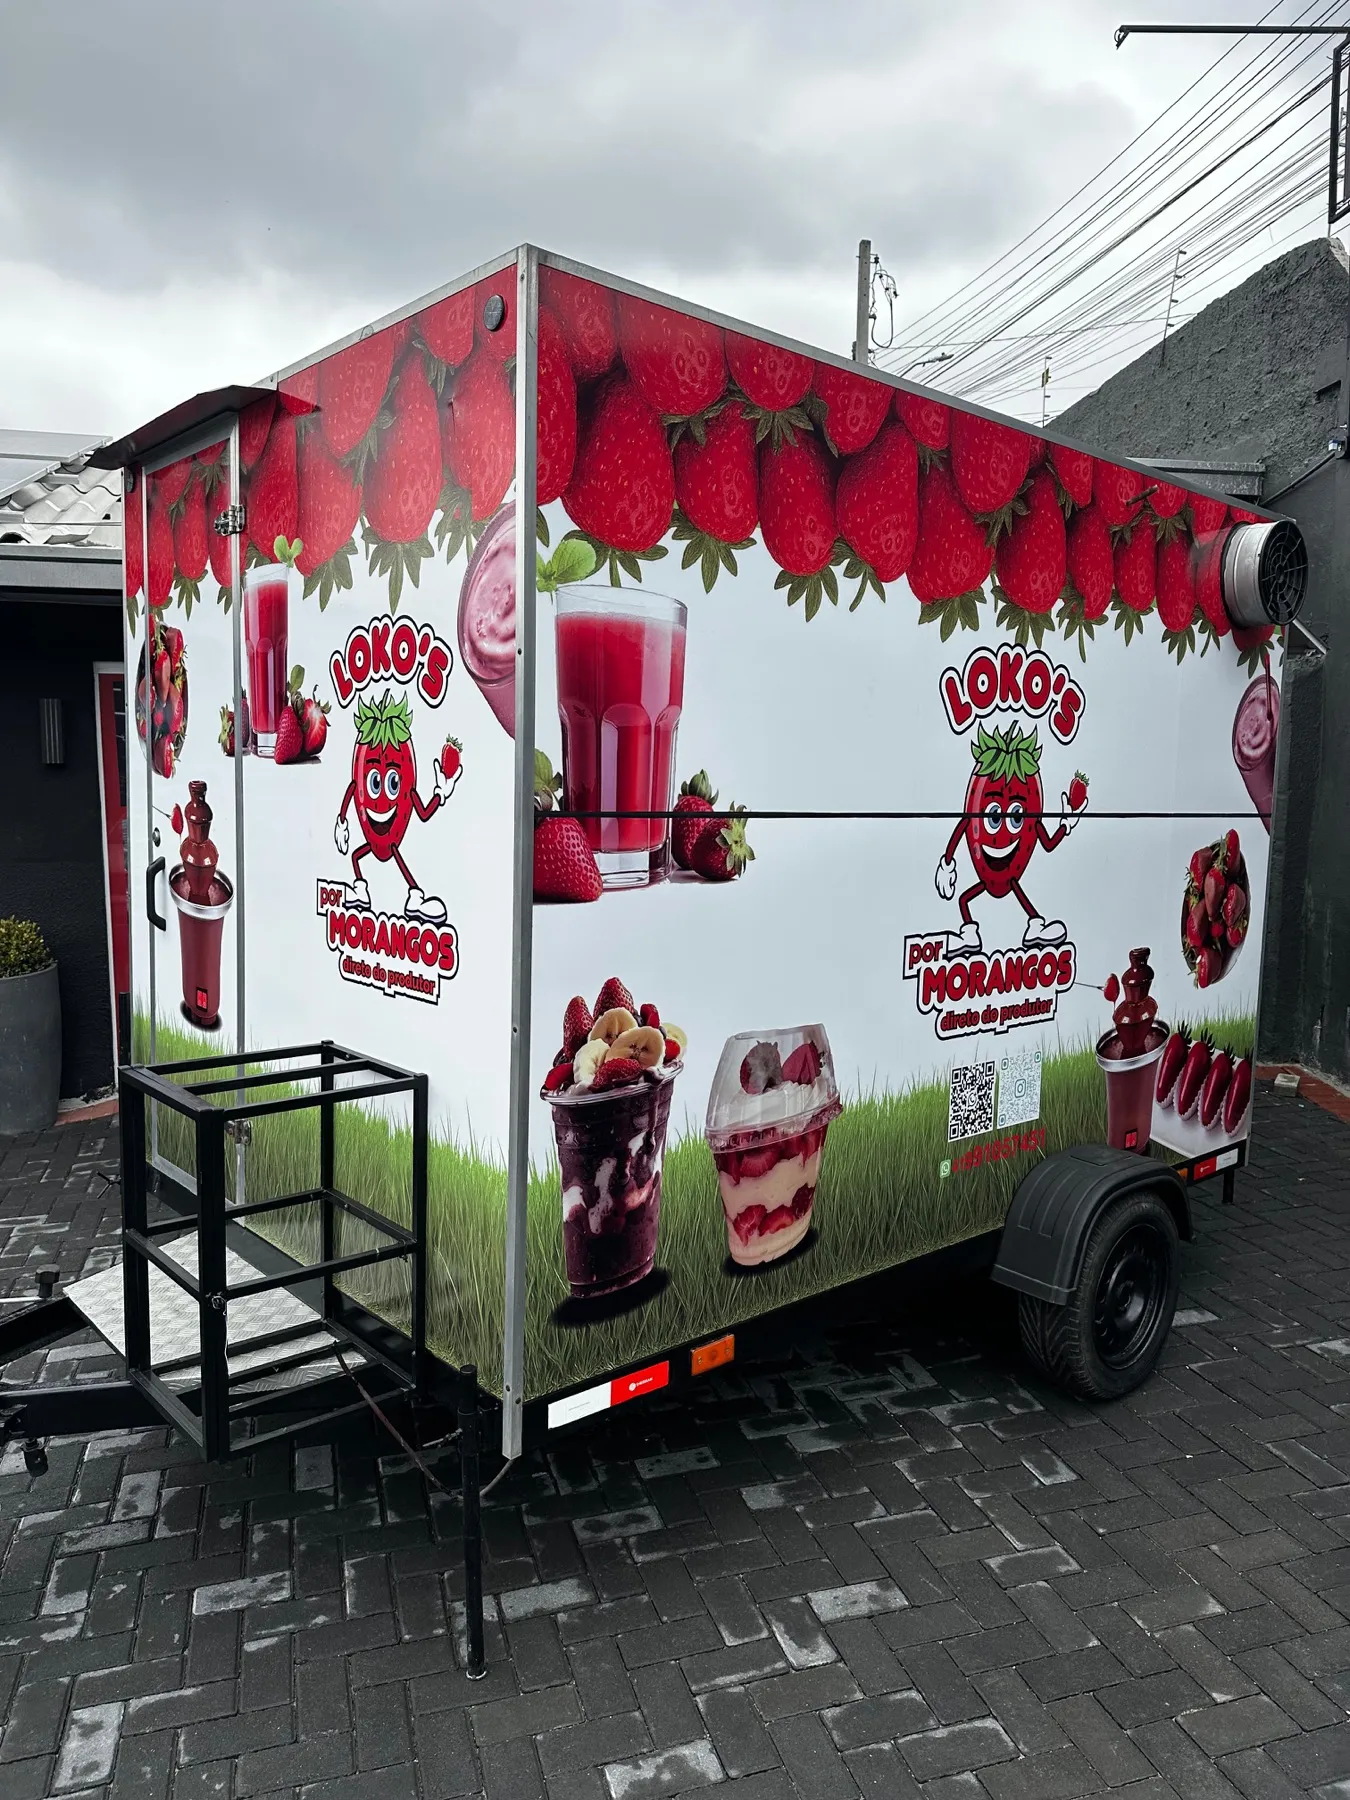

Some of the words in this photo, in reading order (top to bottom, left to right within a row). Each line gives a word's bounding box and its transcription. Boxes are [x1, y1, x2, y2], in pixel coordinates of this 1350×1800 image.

[333, 623, 449, 699] LOKO'S
[945, 653, 1081, 736] LOKO'S
[320, 886, 342, 908] por
[330, 911, 454, 970] MORANGOS
[908, 942, 943, 970] por
[343, 956, 372, 979] direto
[372, 964, 387, 983] do
[388, 970, 436, 995] produtor
[922, 951, 1072, 1004] MORANGOS
[941, 1007, 979, 1030] direto
[981, 1004, 999, 1026] do
[999, 998, 1053, 1026] produtor
